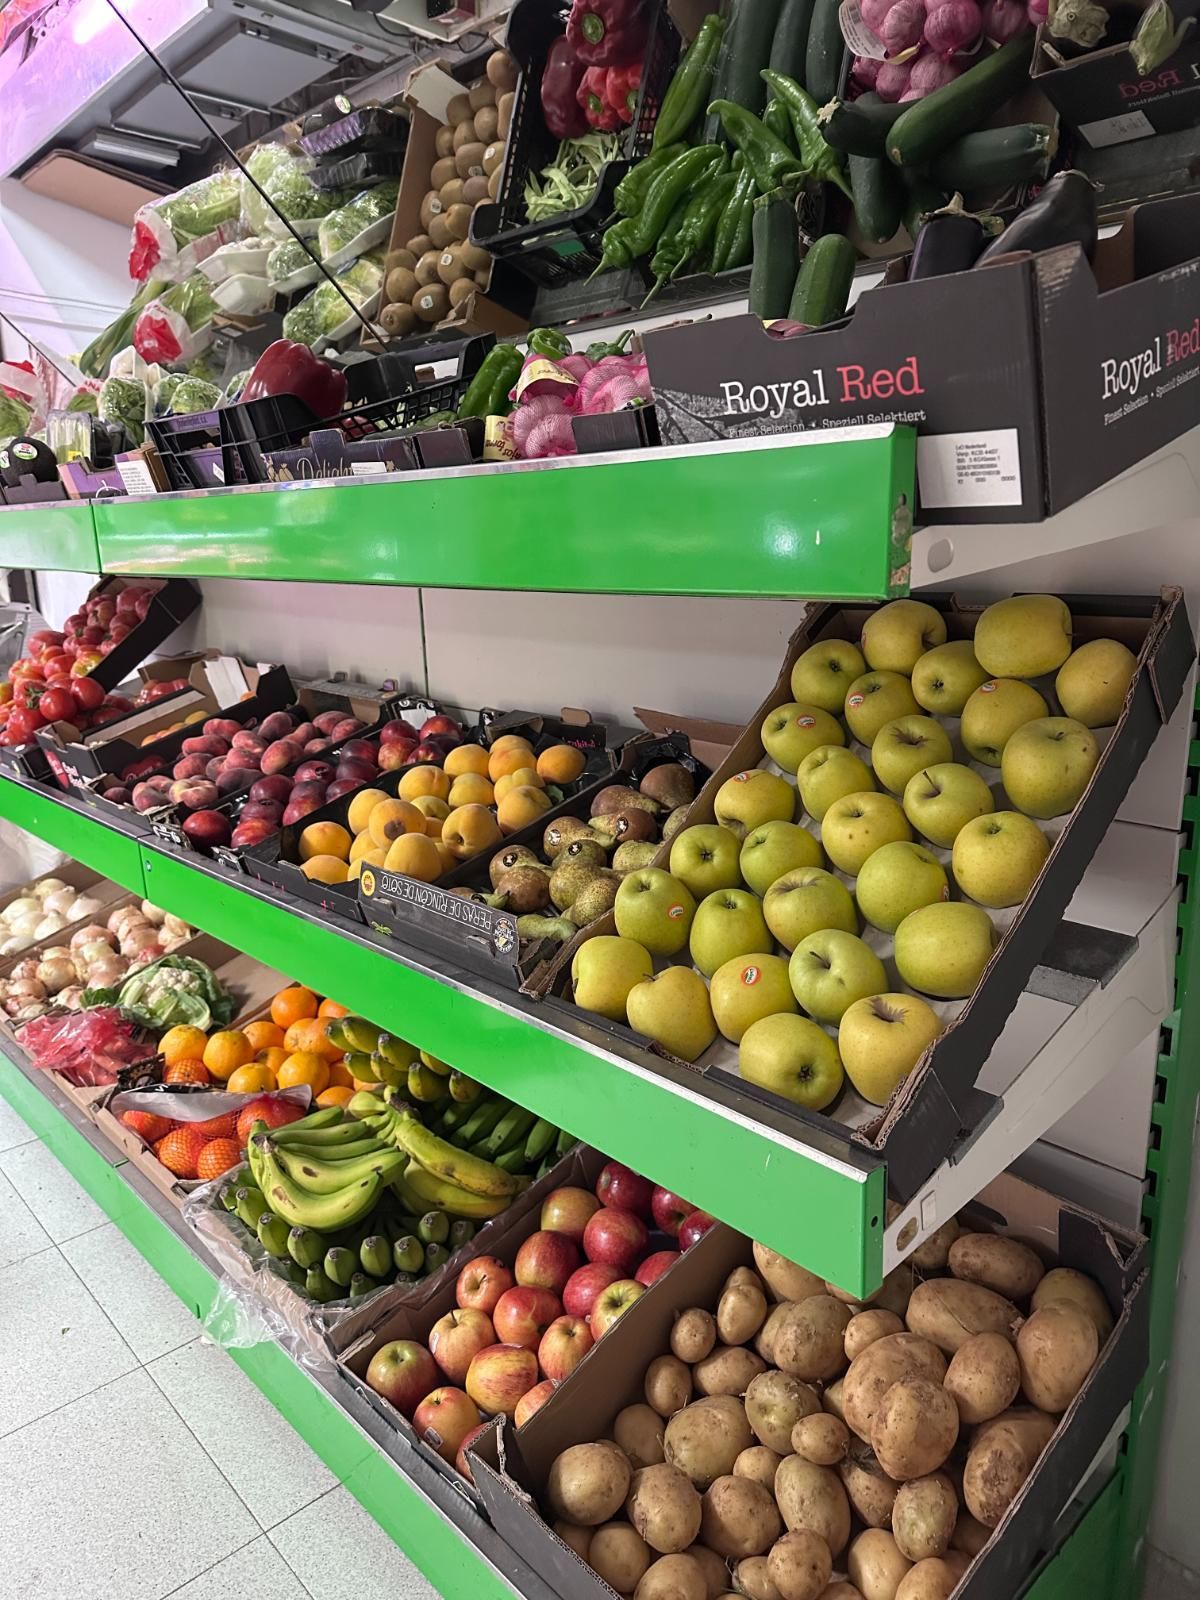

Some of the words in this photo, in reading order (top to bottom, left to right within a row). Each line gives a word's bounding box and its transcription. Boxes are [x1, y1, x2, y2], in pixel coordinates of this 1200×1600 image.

[1101, 336, 1162, 400] Royal
[719, 369, 829, 418] Royal
[836, 356, 925, 403] Red
[381, 875, 403, 895] SOTO
[402, 882, 415, 899] DE
[415, 889, 448, 914] RINCÓN
[449, 900, 462, 917] DE
[462, 905, 492, 930] PERAS
